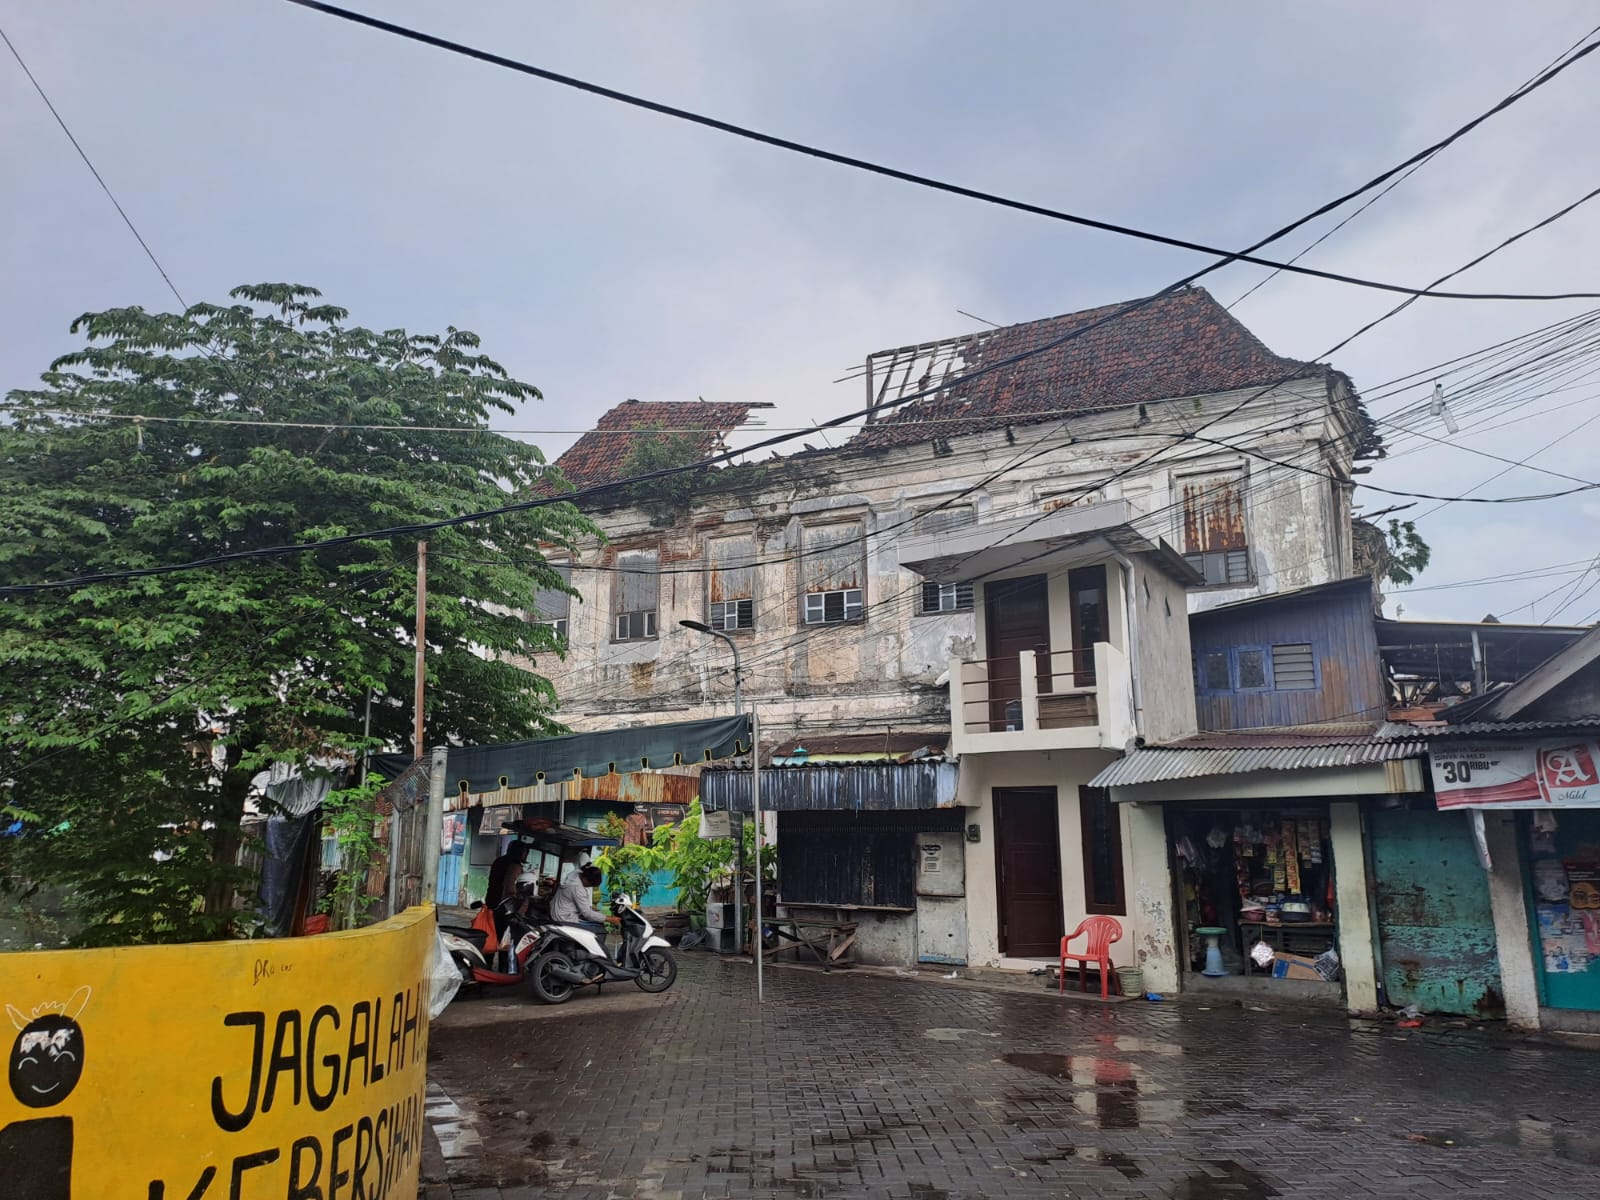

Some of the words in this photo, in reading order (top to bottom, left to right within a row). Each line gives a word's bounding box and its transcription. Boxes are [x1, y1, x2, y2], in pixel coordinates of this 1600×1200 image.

[1443, 761, 1471, 783] 30
[1558, 790, 1587, 800] Mild
[149, 1084, 424, 1200] BERSIHAN
